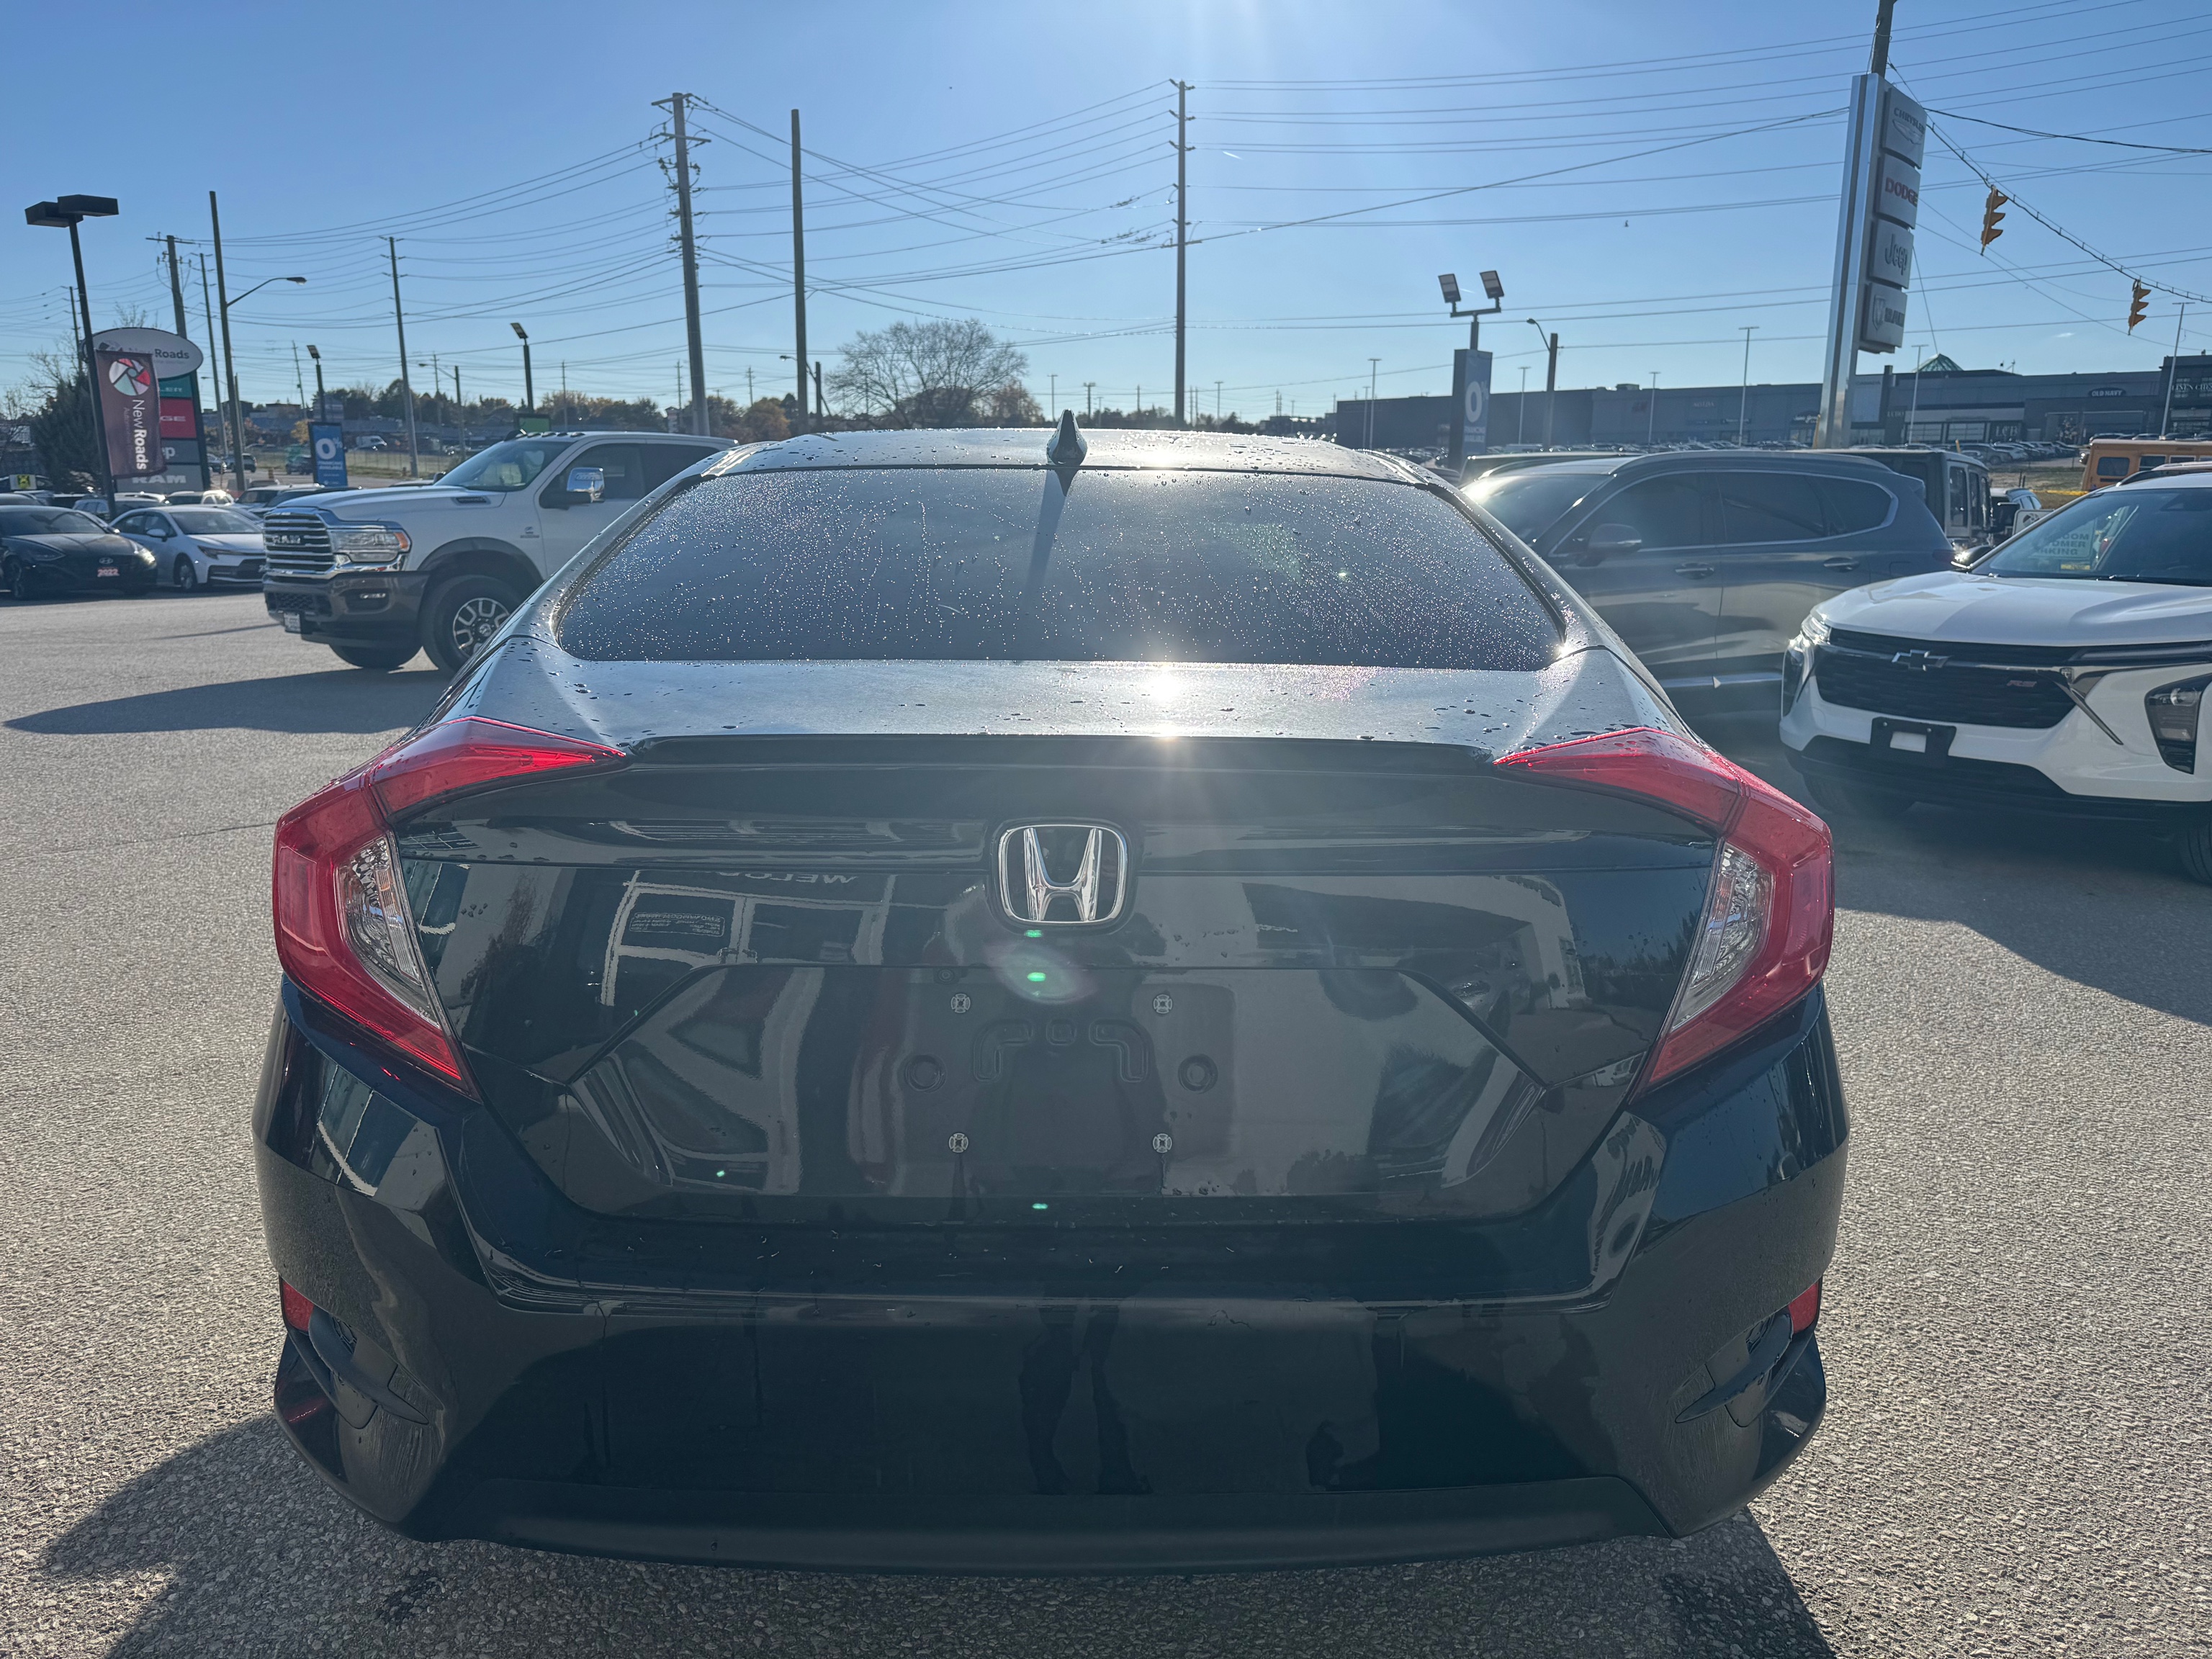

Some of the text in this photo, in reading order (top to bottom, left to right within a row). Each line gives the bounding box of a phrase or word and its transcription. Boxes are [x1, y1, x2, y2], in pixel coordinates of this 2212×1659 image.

[1894, 107, 1925, 135] CHRYSLER
[1885, 176, 1918, 207] DODGE
[1885, 233, 1907, 275] Jeep
[272, 534, 301, 544] RAM
